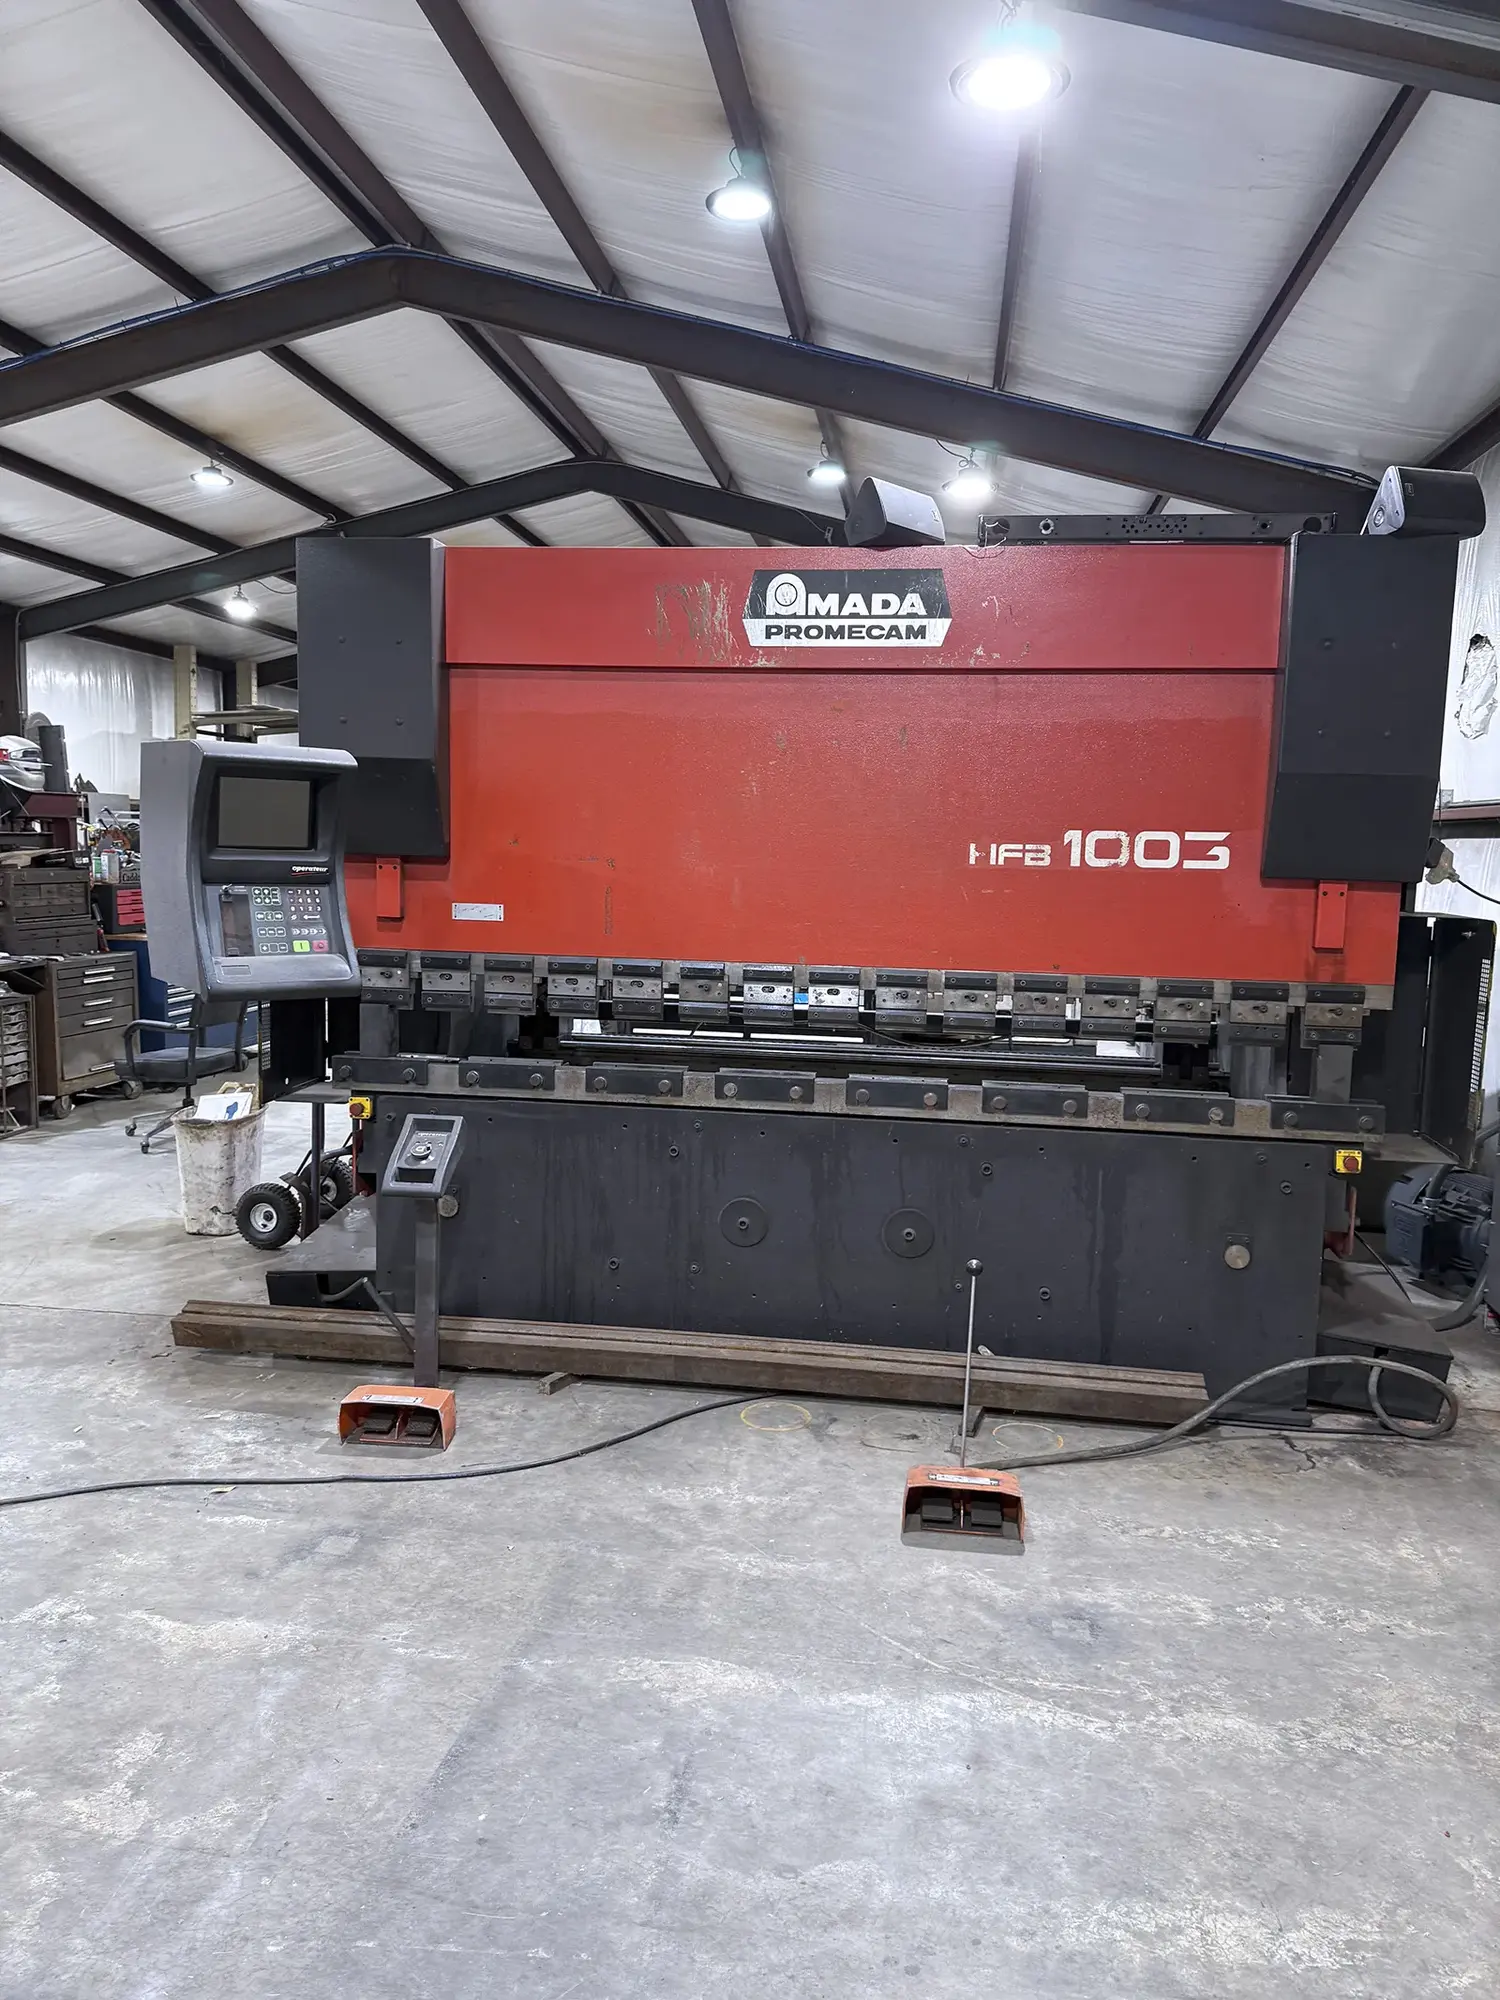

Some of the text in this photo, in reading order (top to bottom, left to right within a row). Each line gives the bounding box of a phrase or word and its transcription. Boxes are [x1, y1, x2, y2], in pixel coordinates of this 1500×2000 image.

[765, 573, 928, 616] AMADA
[765, 624, 927, 640] PROMECAM
[969, 829, 1231, 869] HFB 1003
